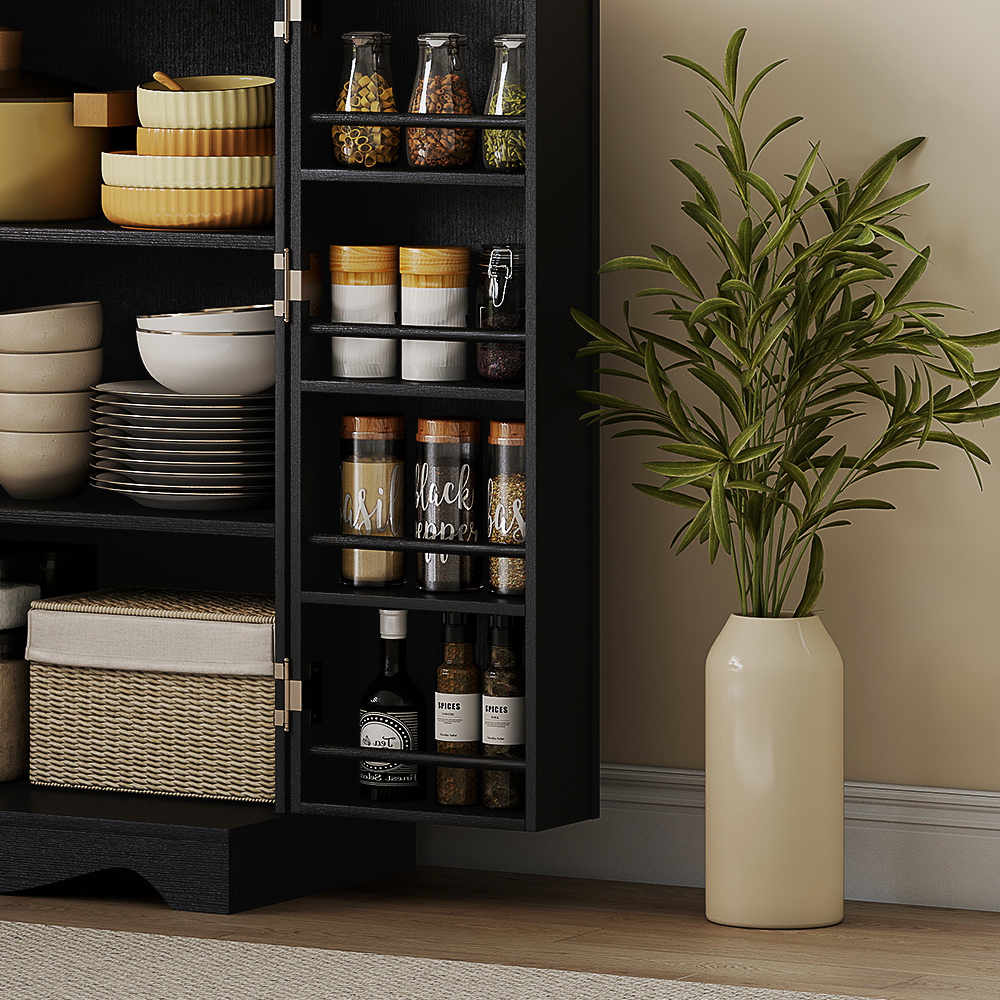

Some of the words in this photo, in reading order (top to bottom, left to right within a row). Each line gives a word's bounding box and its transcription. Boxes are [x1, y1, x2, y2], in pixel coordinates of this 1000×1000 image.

[340, 464, 401, 536] asil
[415, 521, 478, 564] epper
[437, 702, 461, 711] SPICES
[485, 705, 509, 714] SPICES
